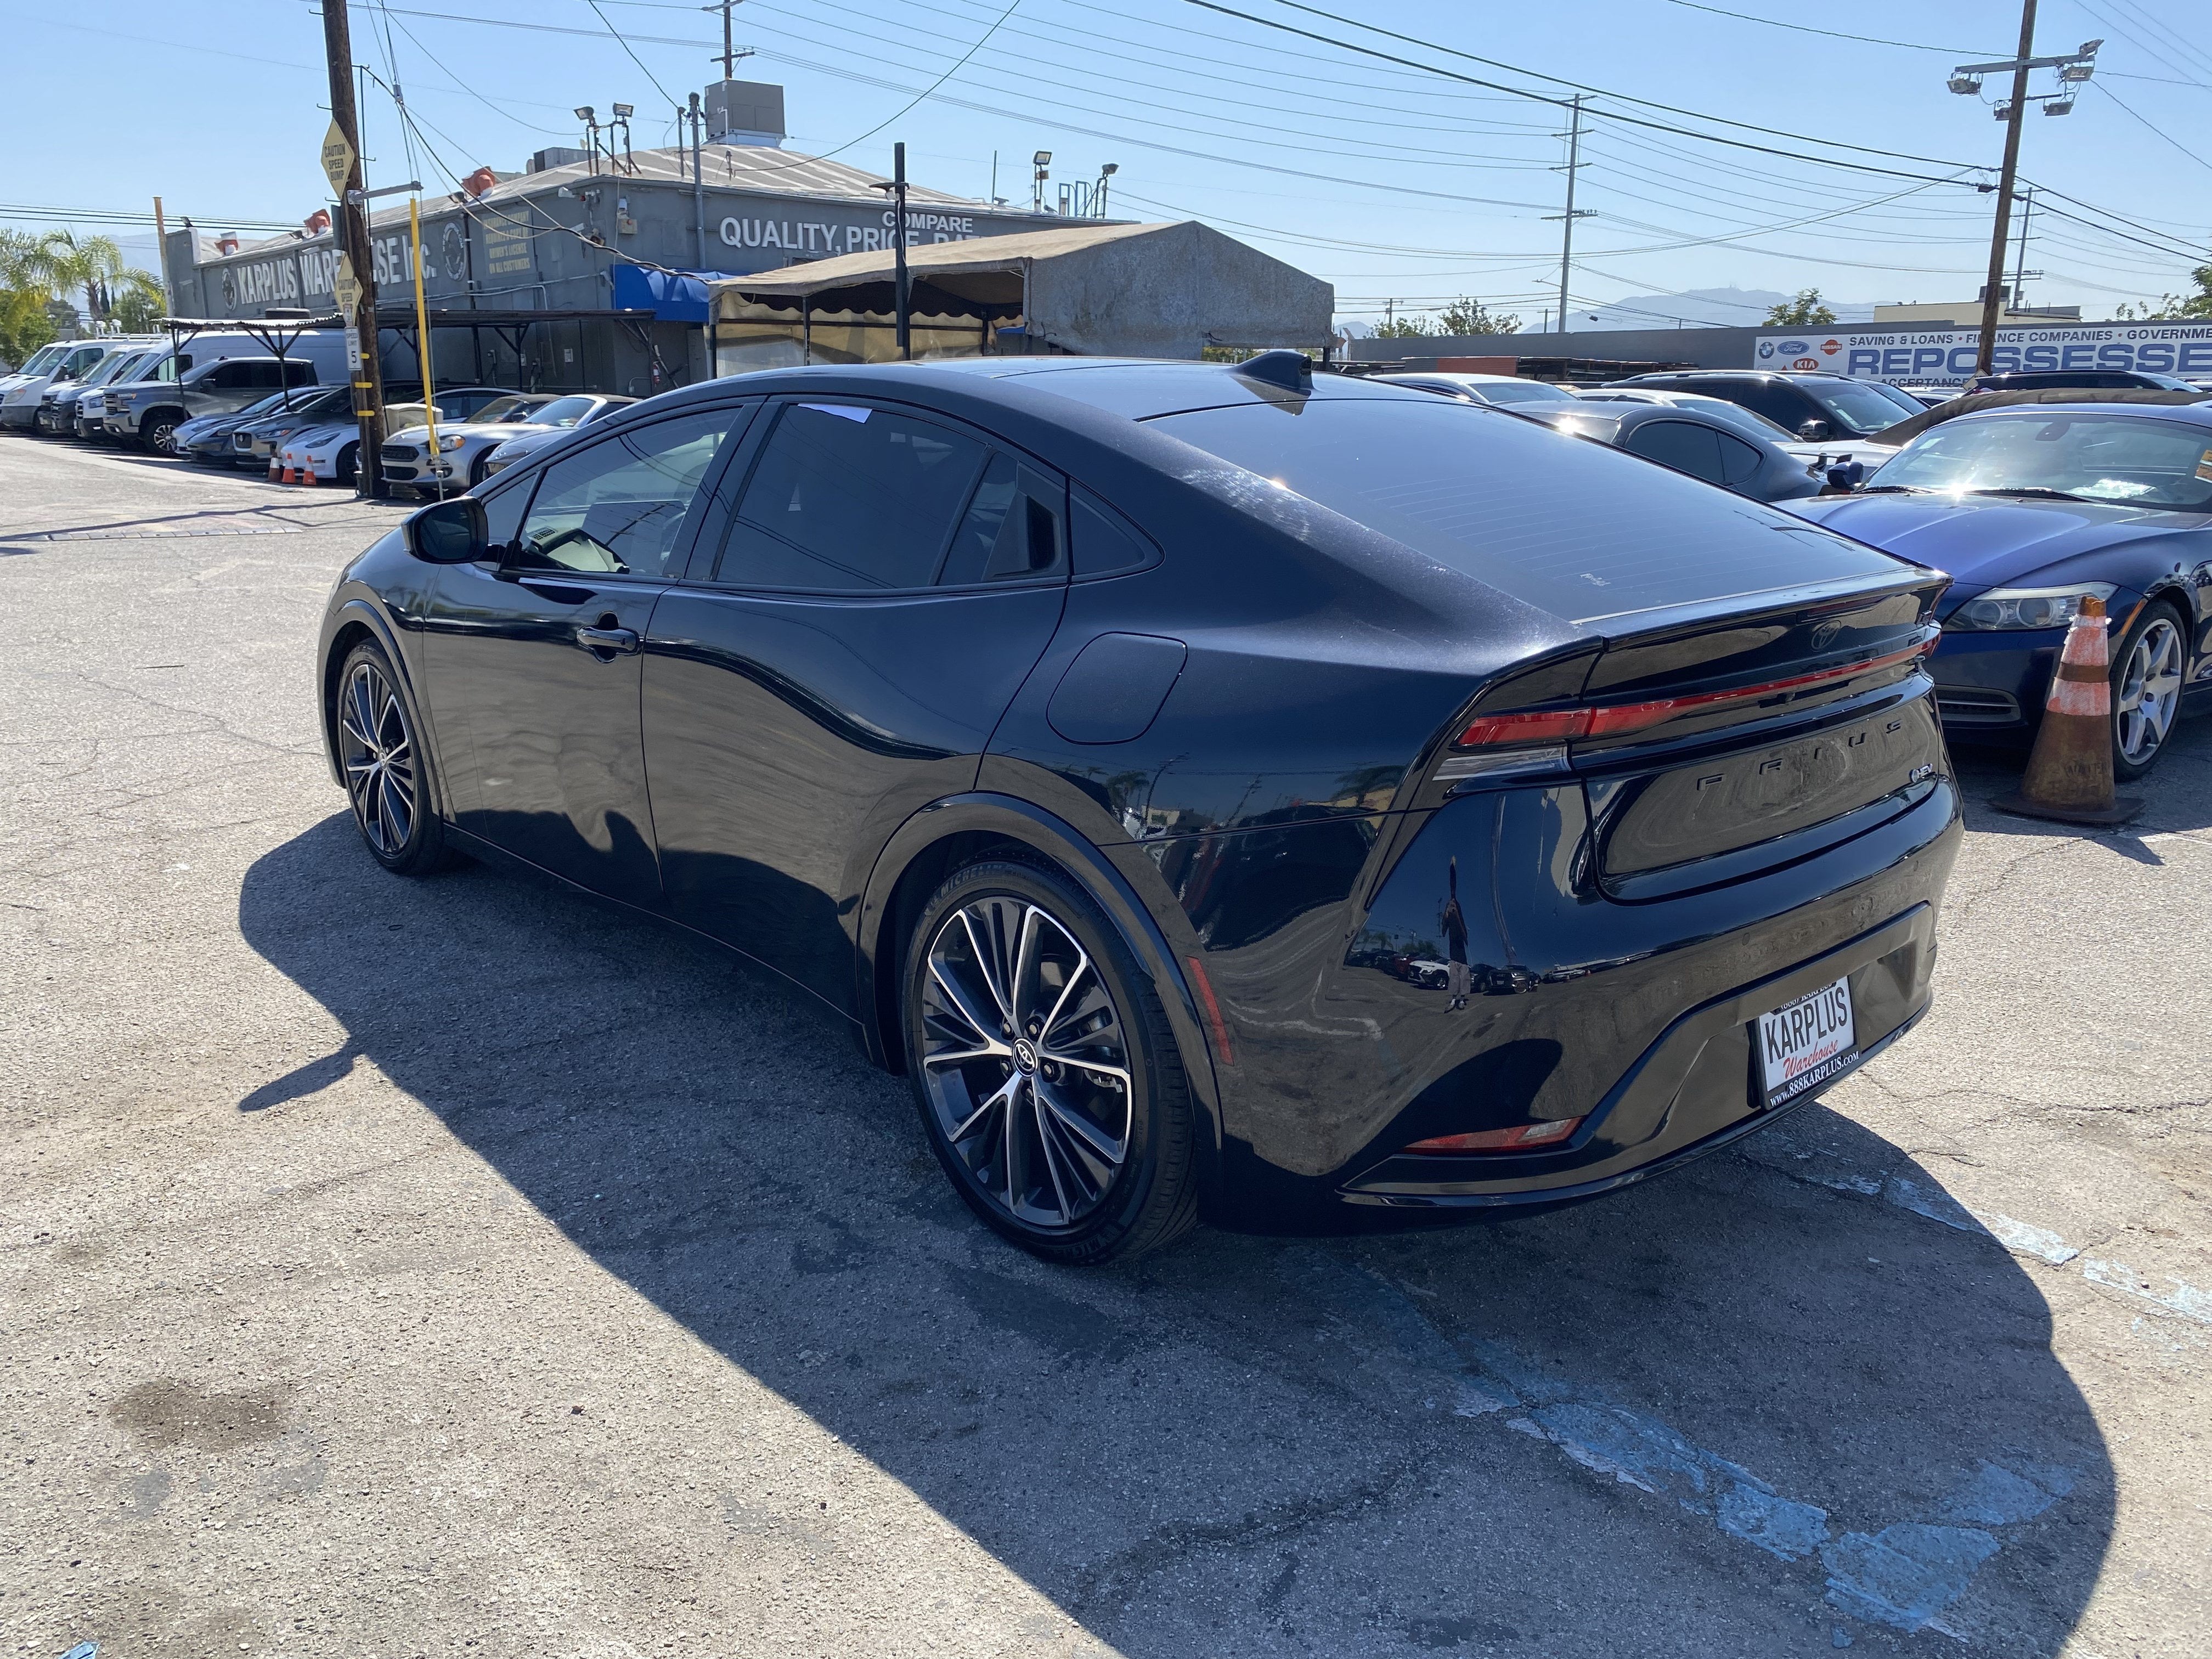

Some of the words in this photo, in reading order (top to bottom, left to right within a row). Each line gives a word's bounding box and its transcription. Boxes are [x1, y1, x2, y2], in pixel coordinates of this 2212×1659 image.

[324, 143, 345, 157] CAUTION
[329, 158, 344, 170] SPEED
[330, 170, 344, 181] BUMP
[719, 217, 842, 254] QUALITY,
[237, 258, 298, 304] KARPLUS
[299, 237, 402, 296] WARESE
[1849, 335, 1895, 346] SAVING
[1900, 335, 1908, 345] &
[1911, 334, 1954, 345] LOANS
[1966, 332, 2025, 343] FINCE
[2029, 330, 2113, 342] COMPANIES
[2127, 328, 2212, 340] GOVERNME
[1784, 343, 1803, 352] Ford
[351, 351, 357, 363] 5
[1796, 360, 1816, 369] KIA
[1765, 986, 1848, 1064] KARPLUS
[1783, 1039, 1838, 1079] Warehouse
